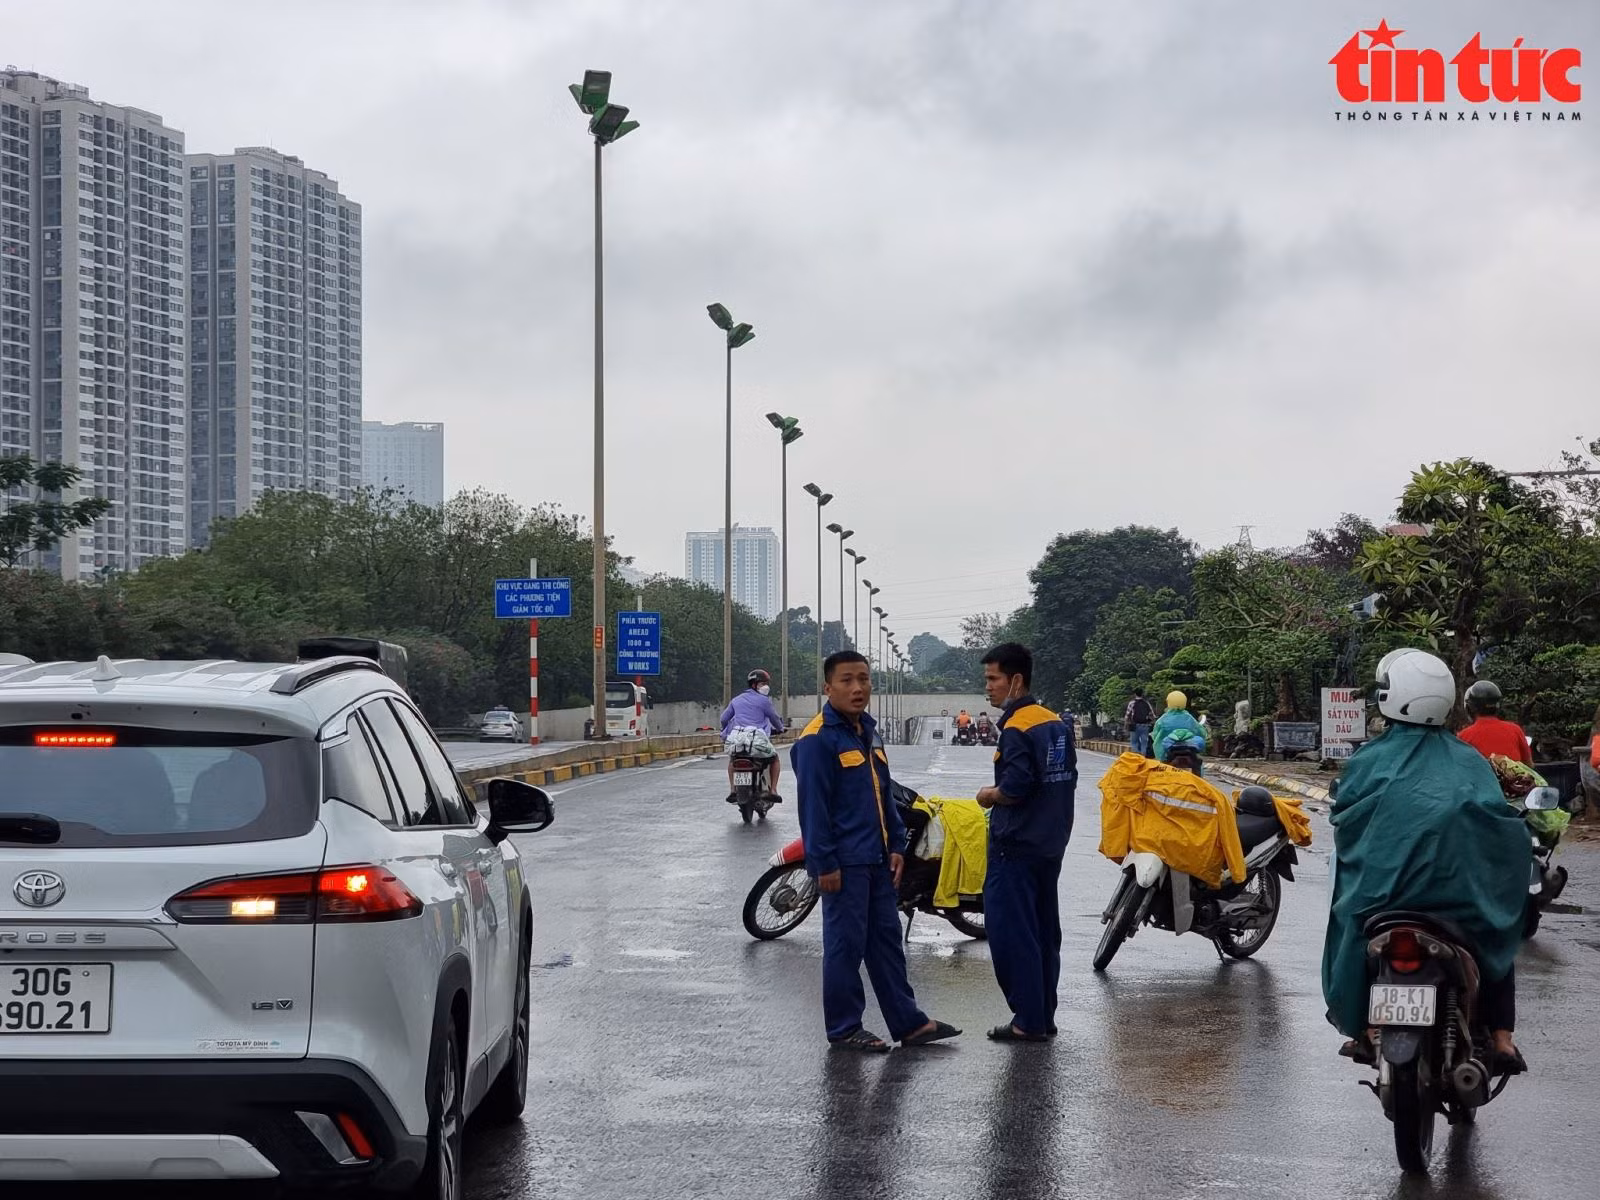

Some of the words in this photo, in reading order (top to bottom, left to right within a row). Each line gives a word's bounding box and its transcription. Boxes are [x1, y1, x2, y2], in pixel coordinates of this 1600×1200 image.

[496, 582, 509, 590] KHU
[541, 581, 552, 590] THI
[505, 593, 518, 602] CÁC
[621, 615, 636, 624] PHÍA
[628, 628, 649, 636] AHEAD
[627, 661, 650, 671] WORKS
[11, 967, 72, 996] 30G
[1381, 988, 1426, 1005] 18-K1
[0, 1001, 91, 1029] 90.21
[1373, 1004, 1431, 1023] 050.94
